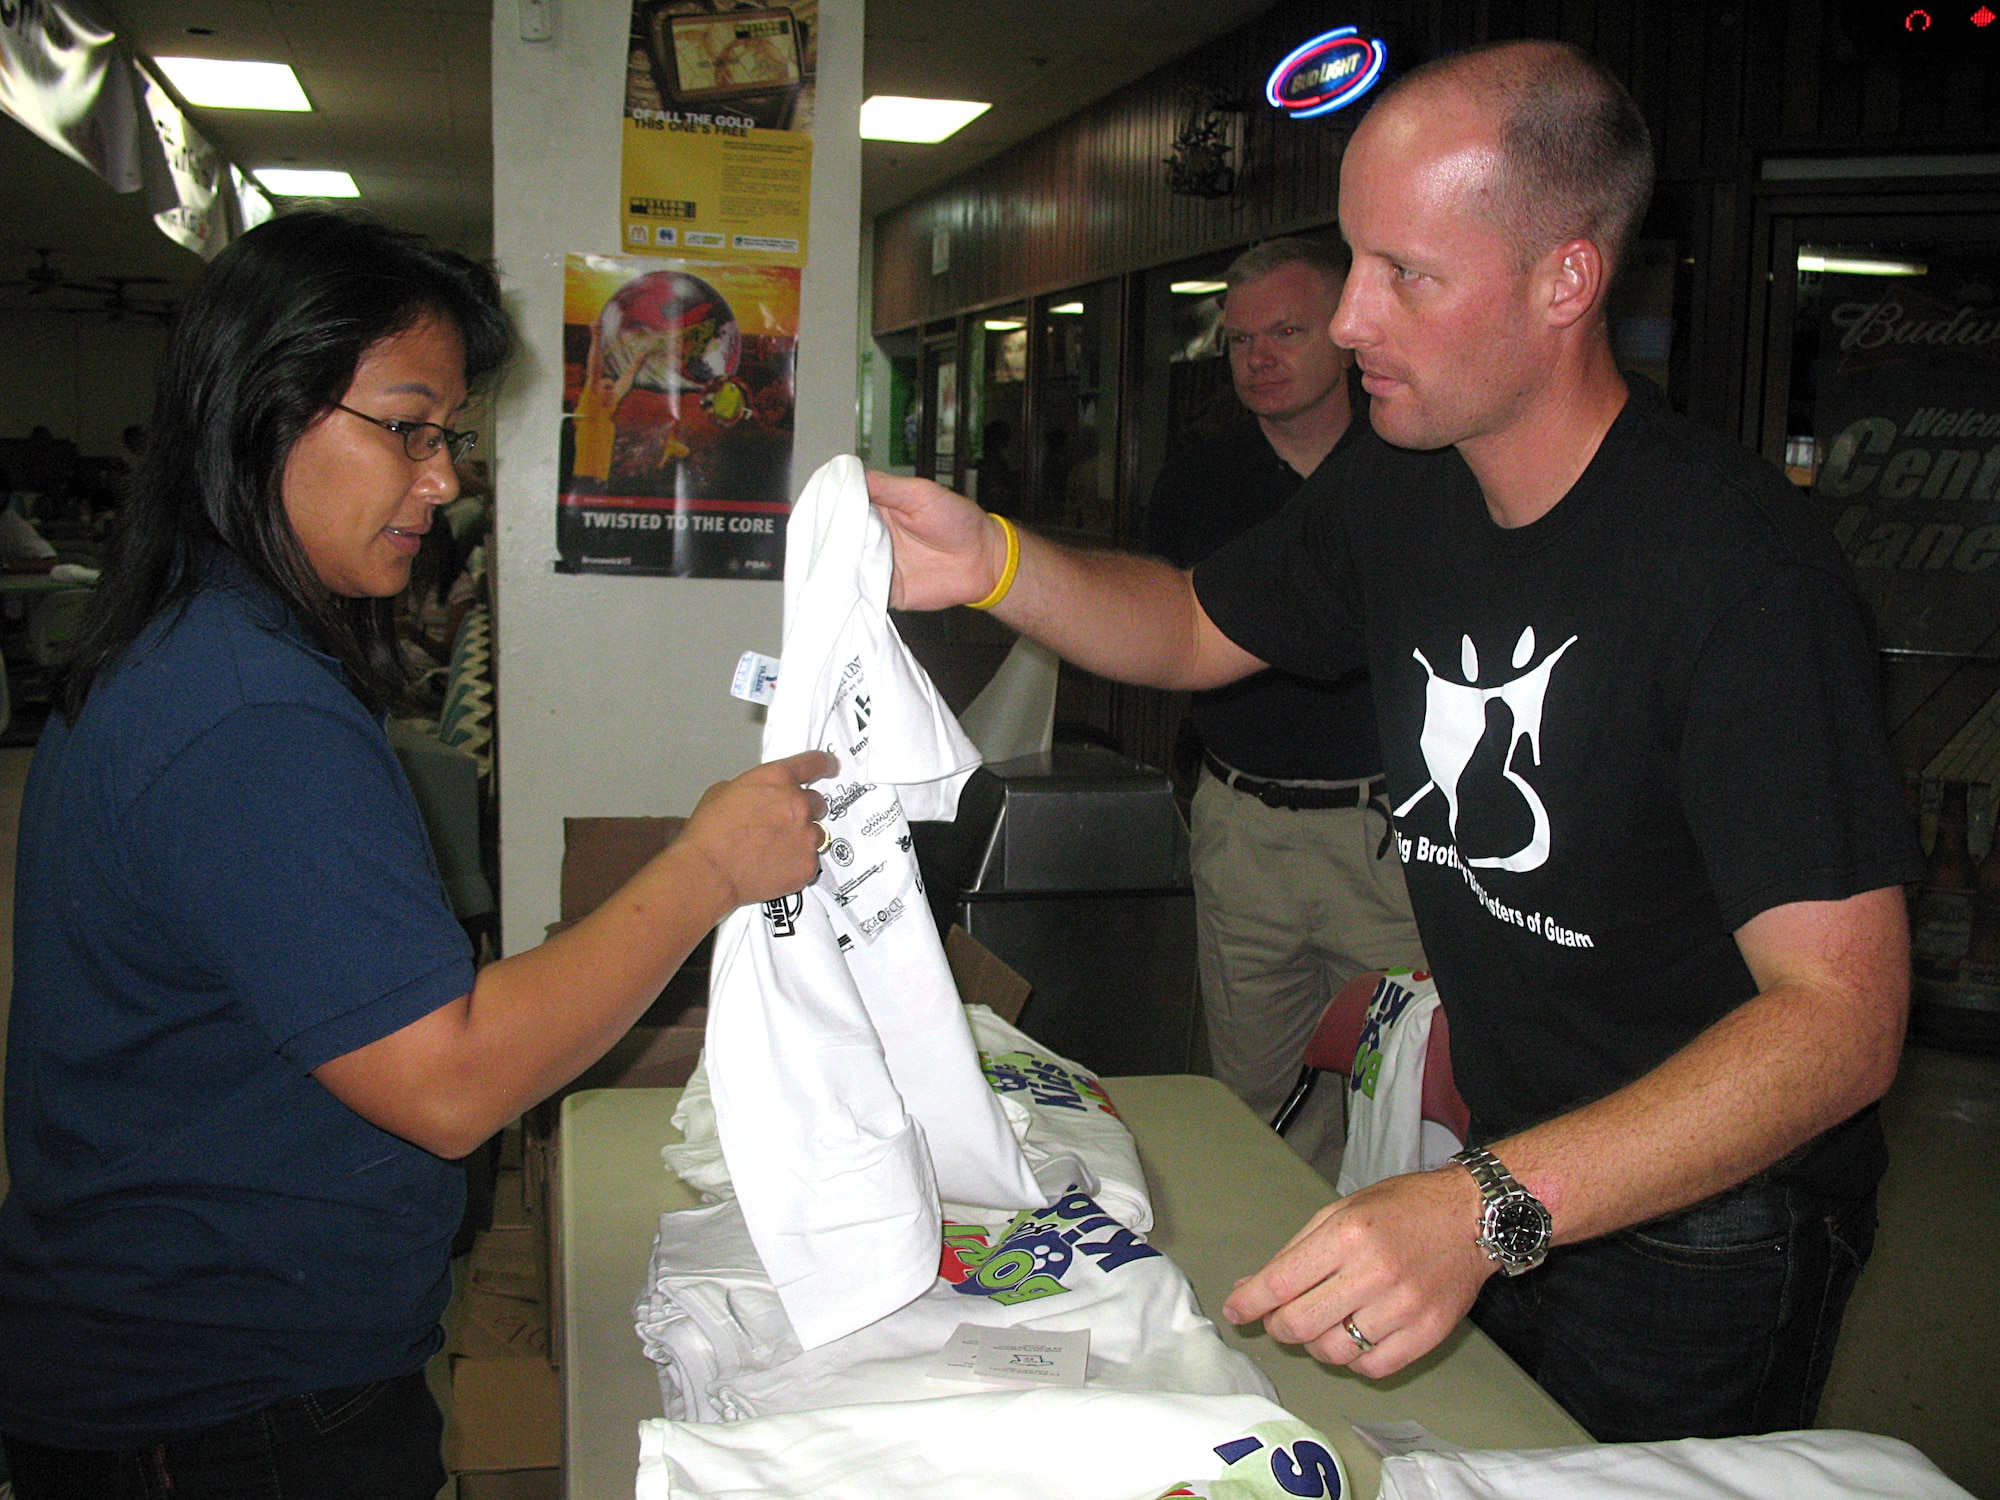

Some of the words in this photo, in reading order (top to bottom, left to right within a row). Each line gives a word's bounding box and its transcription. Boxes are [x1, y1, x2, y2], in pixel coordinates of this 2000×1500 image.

[1319, 52, 1361, 83] LIGHT
[632, 108, 652, 120] OF
[655, 110, 681, 123] ALL
[684, 112, 713, 125] THE
[715, 115, 755, 128] GOLD
[634, 118, 665, 131] THIS
[715, 124, 748, 138] FREE
[582, 511, 661, 530] TWISTED
[664, 514, 688, 531] TO
[692, 515, 725, 533] THE
[728, 517, 775, 534] CORE
[1394, 831, 1412, 864] ig
[1479, 893, 1524, 928] isters
[1527, 911, 1542, 936] of
[1544, 916, 1595, 949] Guam
[1033, 1185, 1164, 1273] Kid
